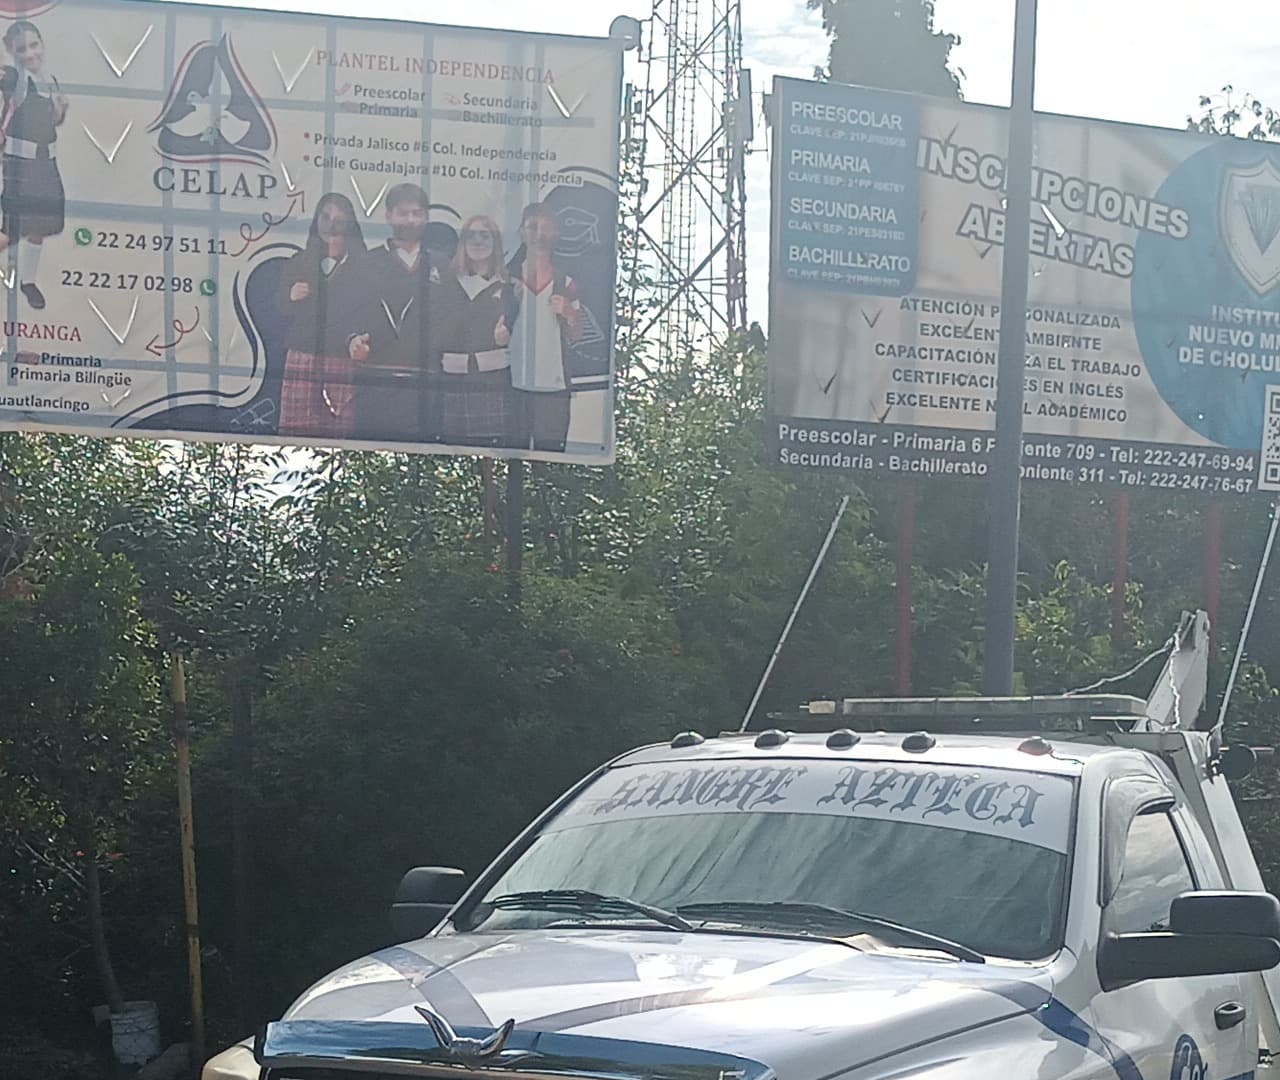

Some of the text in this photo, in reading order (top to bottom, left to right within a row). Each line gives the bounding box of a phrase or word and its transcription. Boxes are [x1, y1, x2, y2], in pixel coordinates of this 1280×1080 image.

[317, 50, 556, 85] PLANTEL INDEPENDENCIA
[354, 84, 427, 103] Preescolar
[463, 93, 538, 112] Secundaria
[360, 102, 420, 119] Primaria
[463, 110, 543, 129] Bachillerato
[791, 101, 904, 131] PREESCOLAR
[314, 133, 558, 164] Privada Jalisco #6 Col. Independencia
[791, 149, 872, 174] PRIMARIA
[154, 166, 278, 200] CELAP
[314, 155, 583, 187] Calle Guadalajara #10 Col. Independencia
[916, 136, 1191, 241] INSCIPCIONES
[790, 197, 898, 225] SECUNDARIA
[98, 232, 228, 255] 22 24 97 51 11
[957, 204, 1136, 278] ABERTAS
[789, 245, 911, 273] BACHILLERATO
[61, 270, 193, 294] 22 22 17 02 98
[900, 297, 1121, 331] ATENCIÓN PSONALIZADA
[4, 322, 83, 343] URANGA
[920, 322, 1000, 342] EXCELEN
[1188, 324, 1255, 348] NUEVO
[41, 352, 103, 369] Primaria
[875, 343, 996, 366] CAPACITACIÓN
[1048, 356, 1065, 371] EL
[1071, 359, 1141, 378] TRABAJO
[1179, 346, 1205, 365] DE
[10, 367, 133, 393] Primaria Bilingüe
[1044, 380, 1064, 394] EN
[1069, 382, 1124, 400] INGLÉS
[886, 392, 980, 413] EXCELENTE
[1037, 403, 1128, 423] ACADÉMICO
[779, 424, 878, 448] Preescolar
[894, 431, 967, 454] Primaria
[972, 437, 982, 453] 6
[1067, 443, 1095, 461] 709
[1110, 446, 1139, 465] Tel:
[1143, 449, 1255, 473] 222-247-69-94
[780, 447, 874, 470] Secundaria
[889, 455, 989, 477] Bachillerato
[1079, 467, 1105, 483] 311
[1119, 469, 1147, 487] Tel:
[1151, 472, 1255, 494] 222-247-76-67
